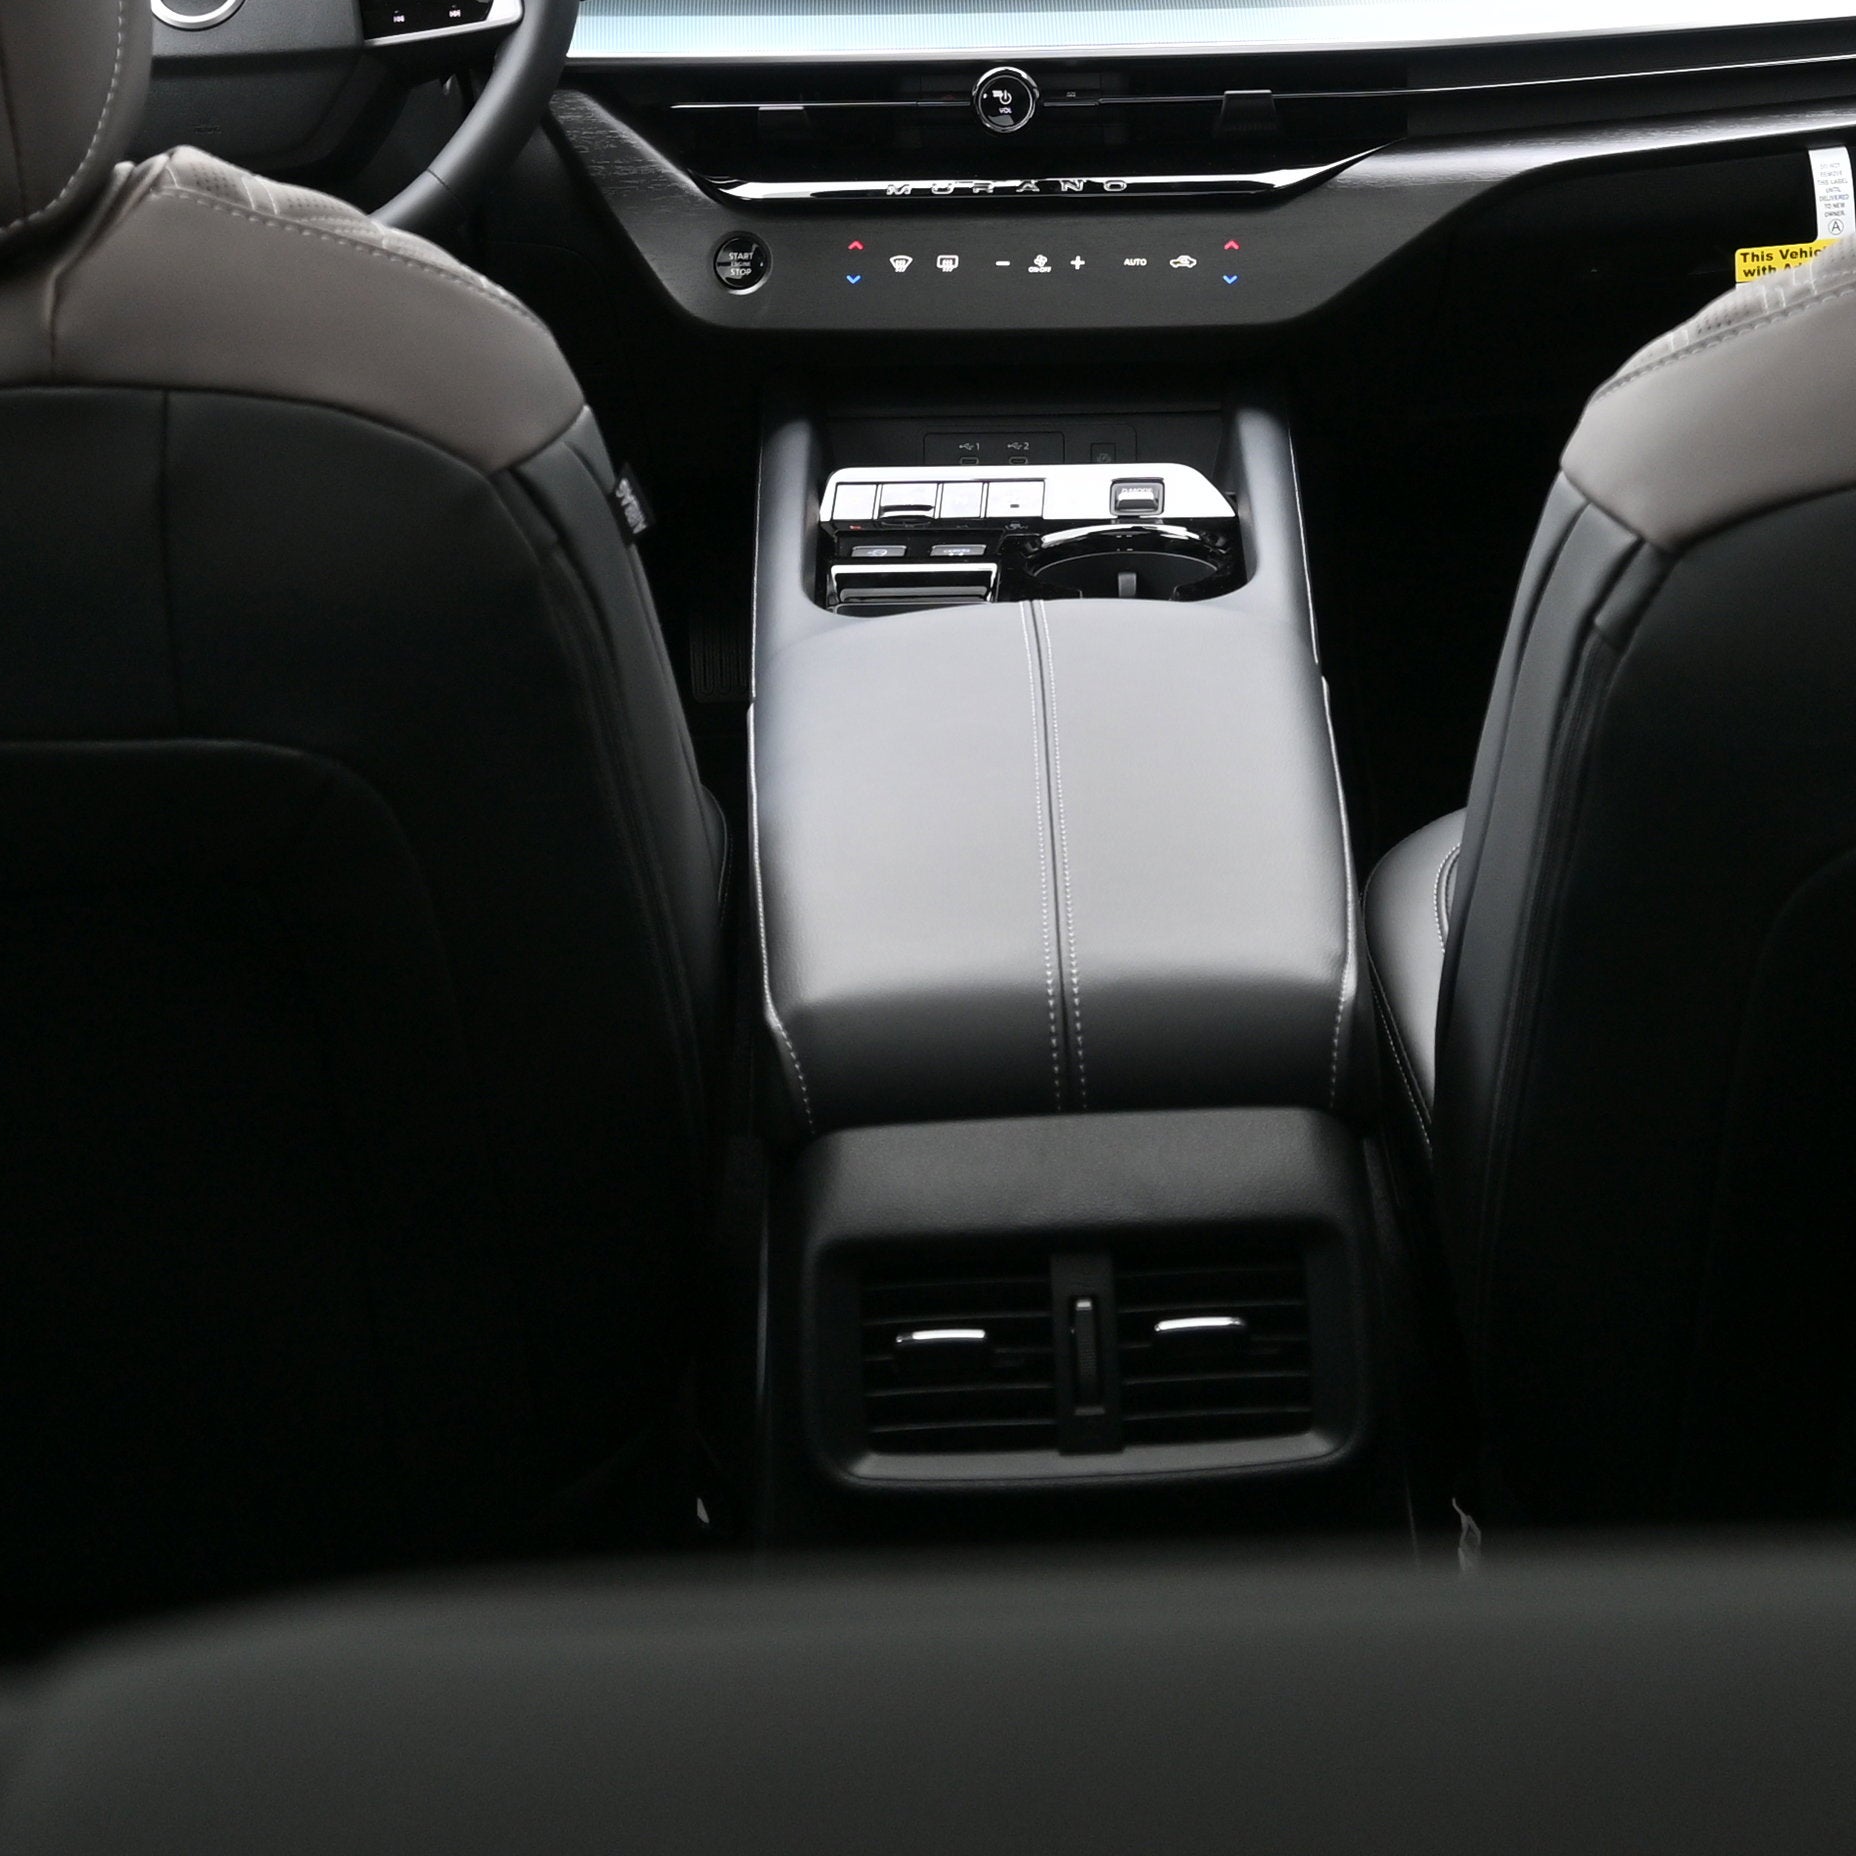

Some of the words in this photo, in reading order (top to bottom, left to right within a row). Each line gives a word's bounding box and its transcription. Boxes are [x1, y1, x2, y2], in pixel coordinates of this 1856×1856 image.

[886, 179, 1127, 196] MURANO
[728, 252, 754, 261] START
[1740, 251, 1774, 263] This
[1779, 247, 1826, 261] Vehic
[1123, 258, 1148, 267] AUTO
[730, 268, 753, 276] STOP
[1743, 264, 1777, 277] with
